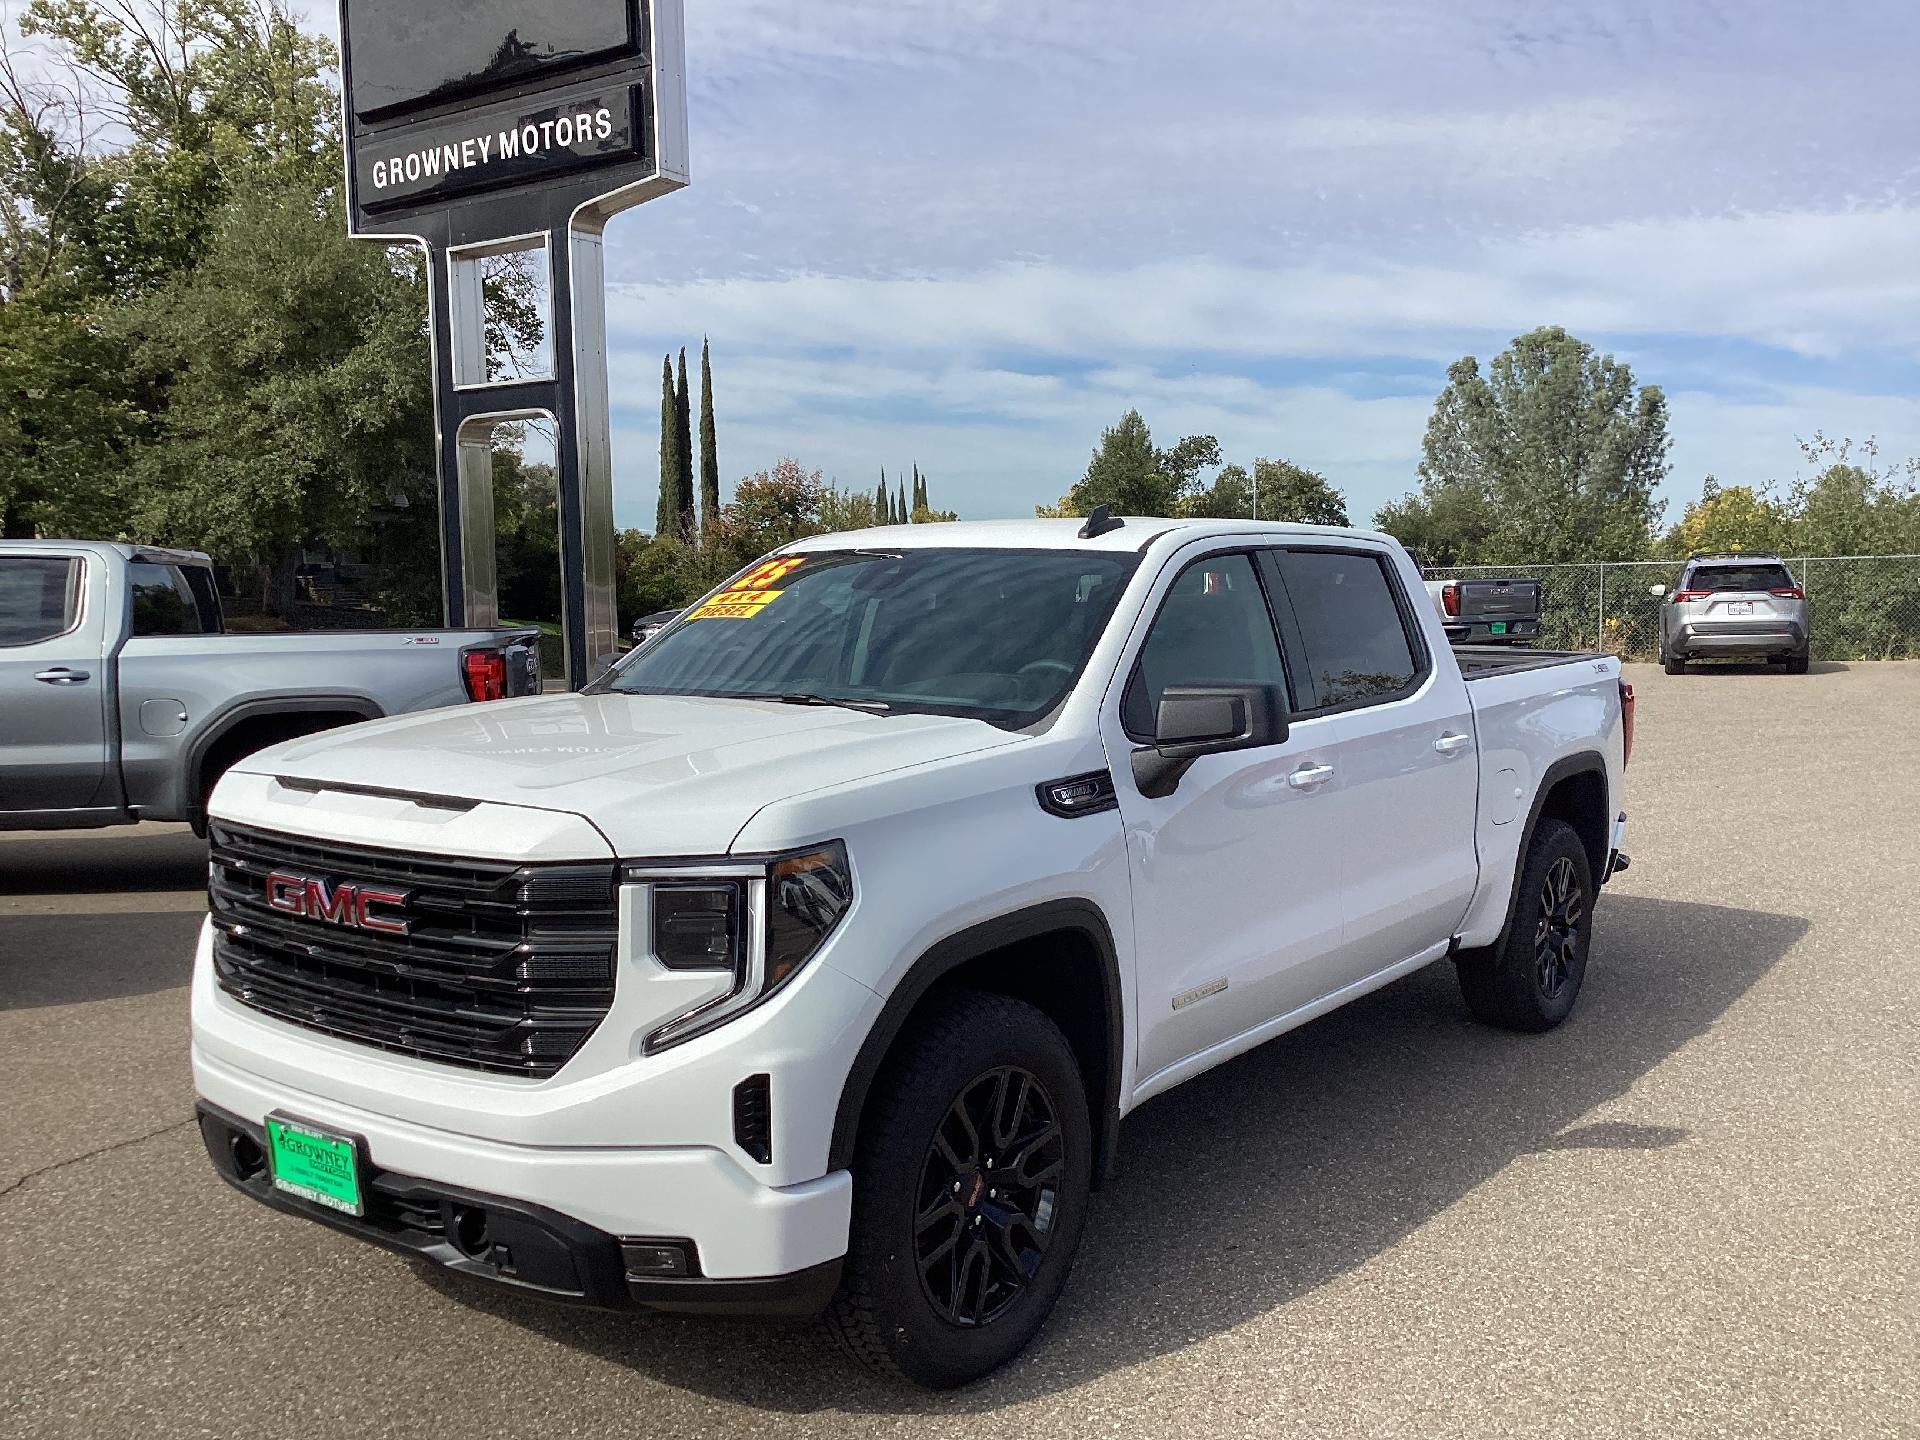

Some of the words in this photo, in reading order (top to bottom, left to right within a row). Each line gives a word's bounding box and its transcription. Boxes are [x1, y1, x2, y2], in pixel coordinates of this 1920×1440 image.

[372, 134, 492, 189] GROWNEY
[499, 108, 612, 160] MOTORS
[266, 871, 409, 936] GMC
[286, 1138, 349, 1171] GROWNEY
